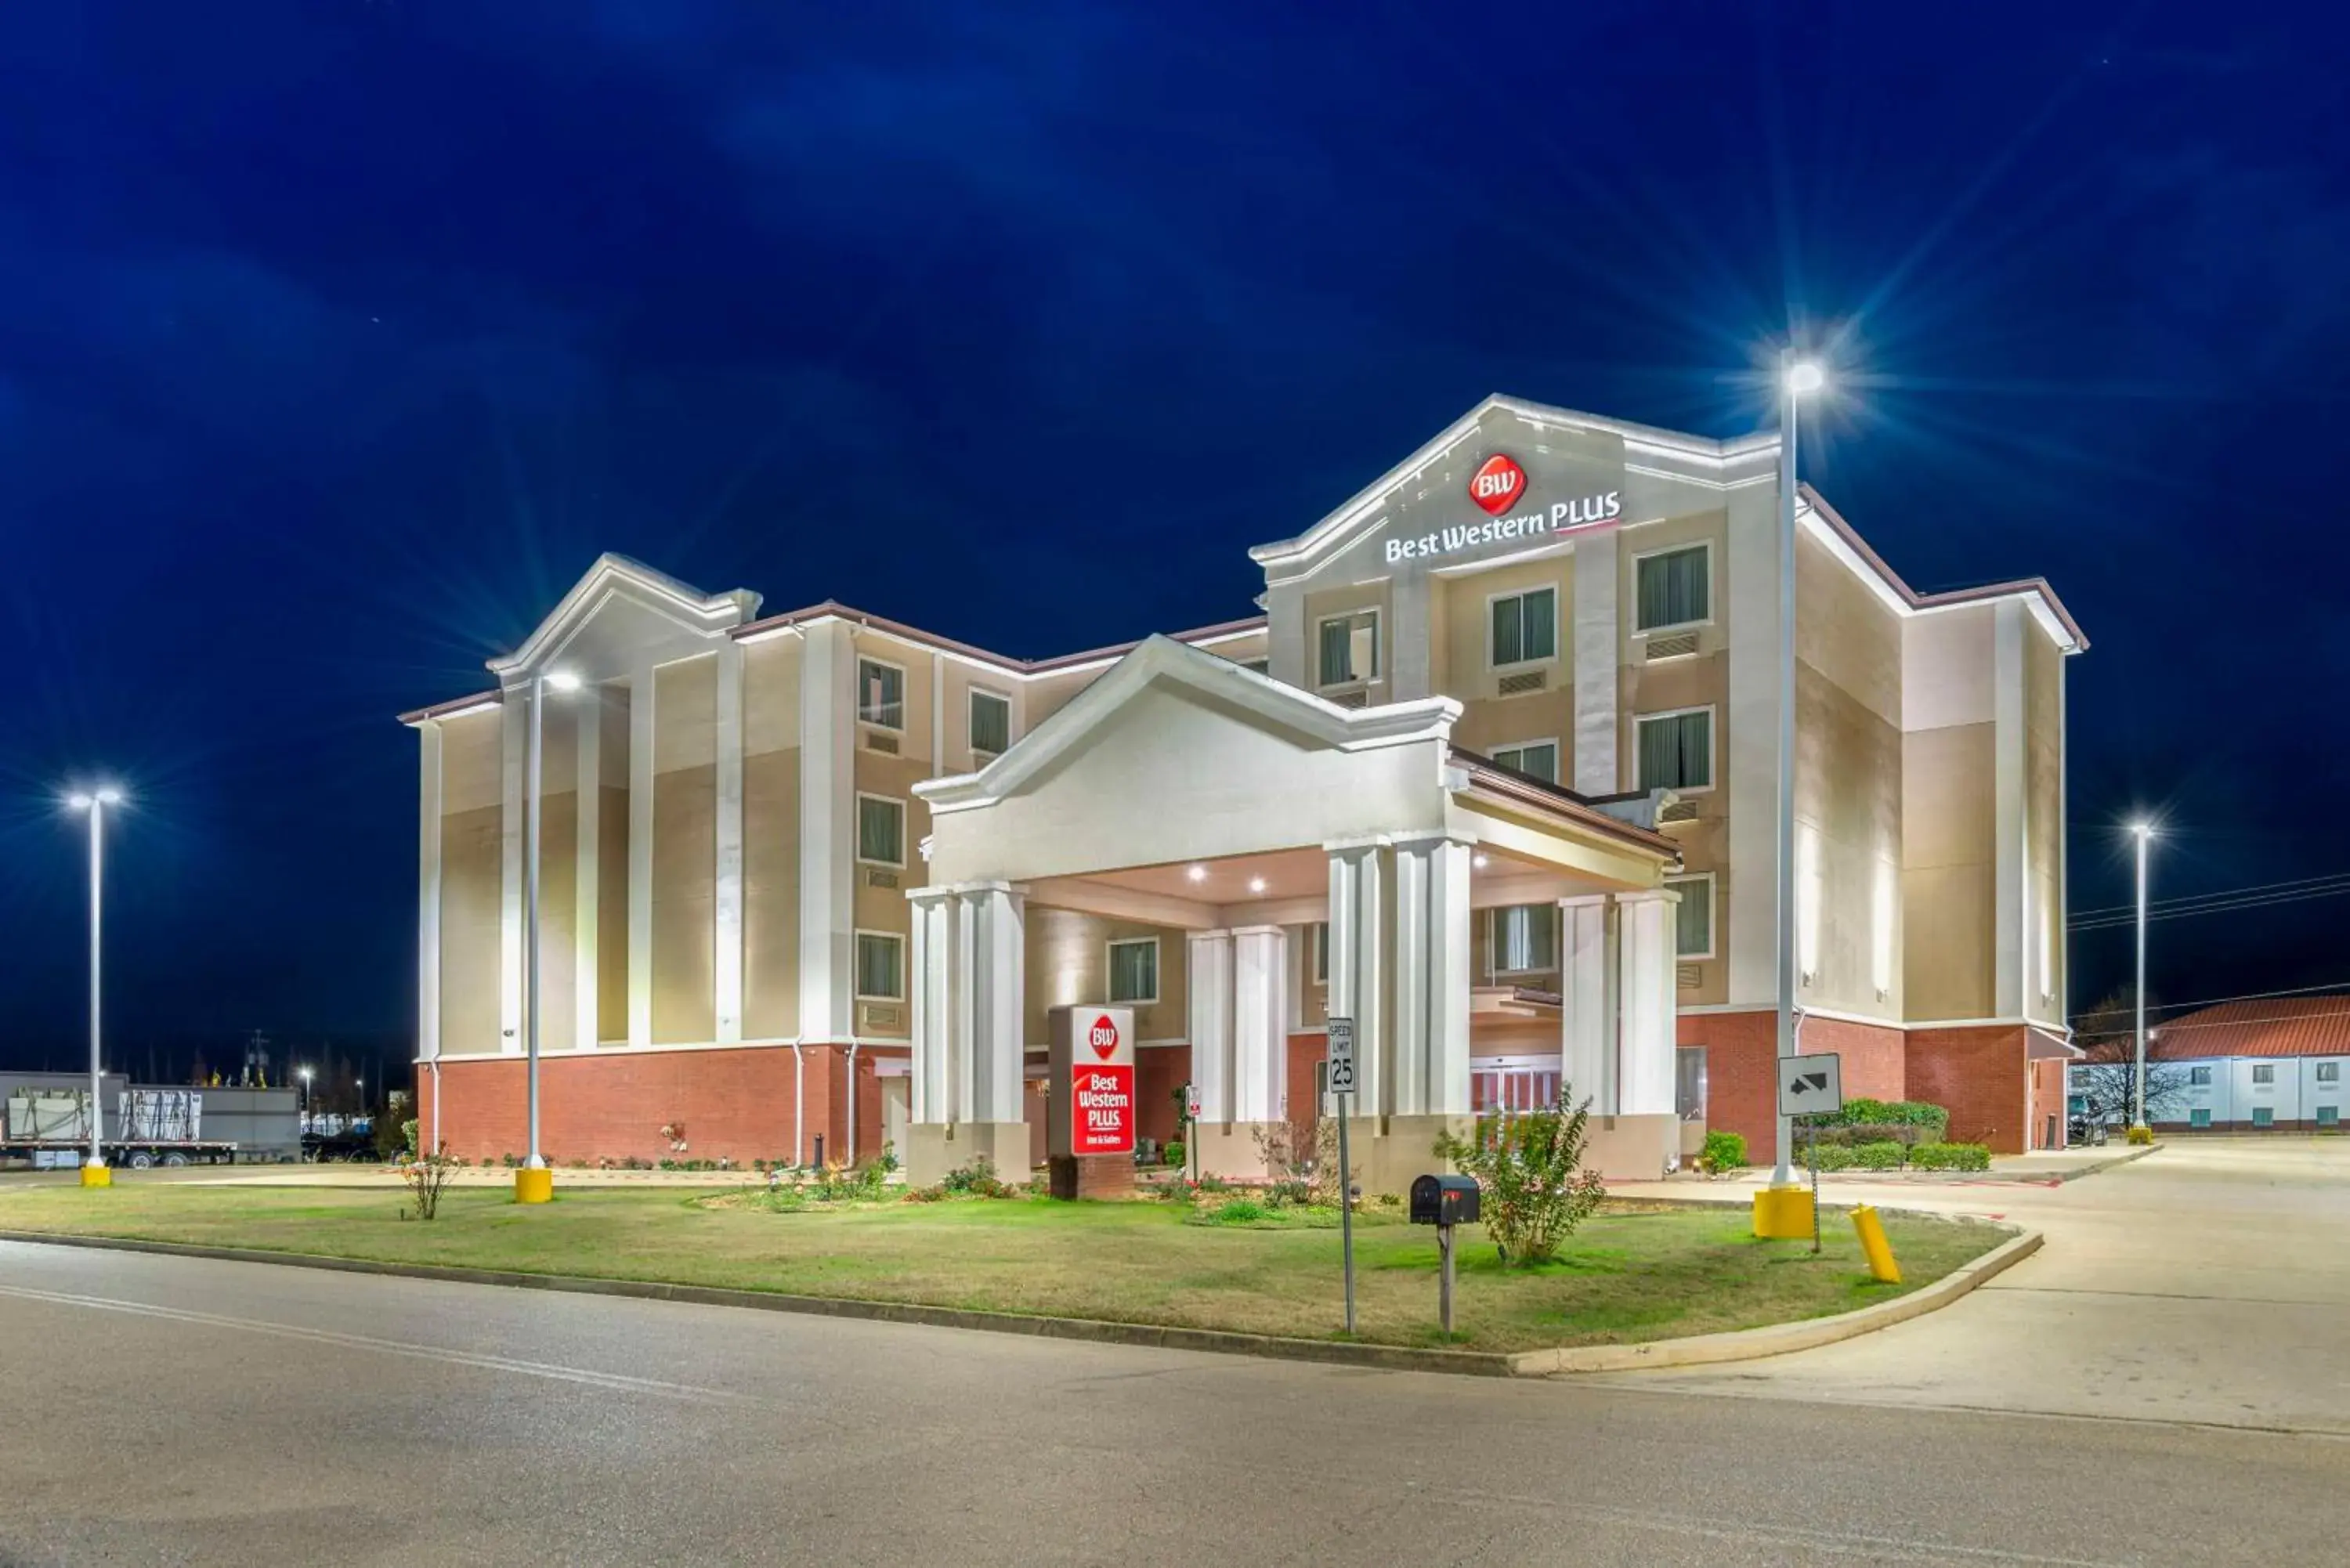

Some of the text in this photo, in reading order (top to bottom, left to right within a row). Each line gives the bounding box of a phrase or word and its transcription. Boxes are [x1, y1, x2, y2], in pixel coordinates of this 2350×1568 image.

[1478, 471, 1516, 497] BW
[1386, 491, 1622, 562] Best Western PLUS
[1093, 1028, 1115, 1046] BW
[1332, 1058, 1353, 1085] 25
[1091, 1074, 1118, 1090] Best
[1079, 1090, 1128, 1107] Western
[1089, 1110, 1121, 1126] PLUS
